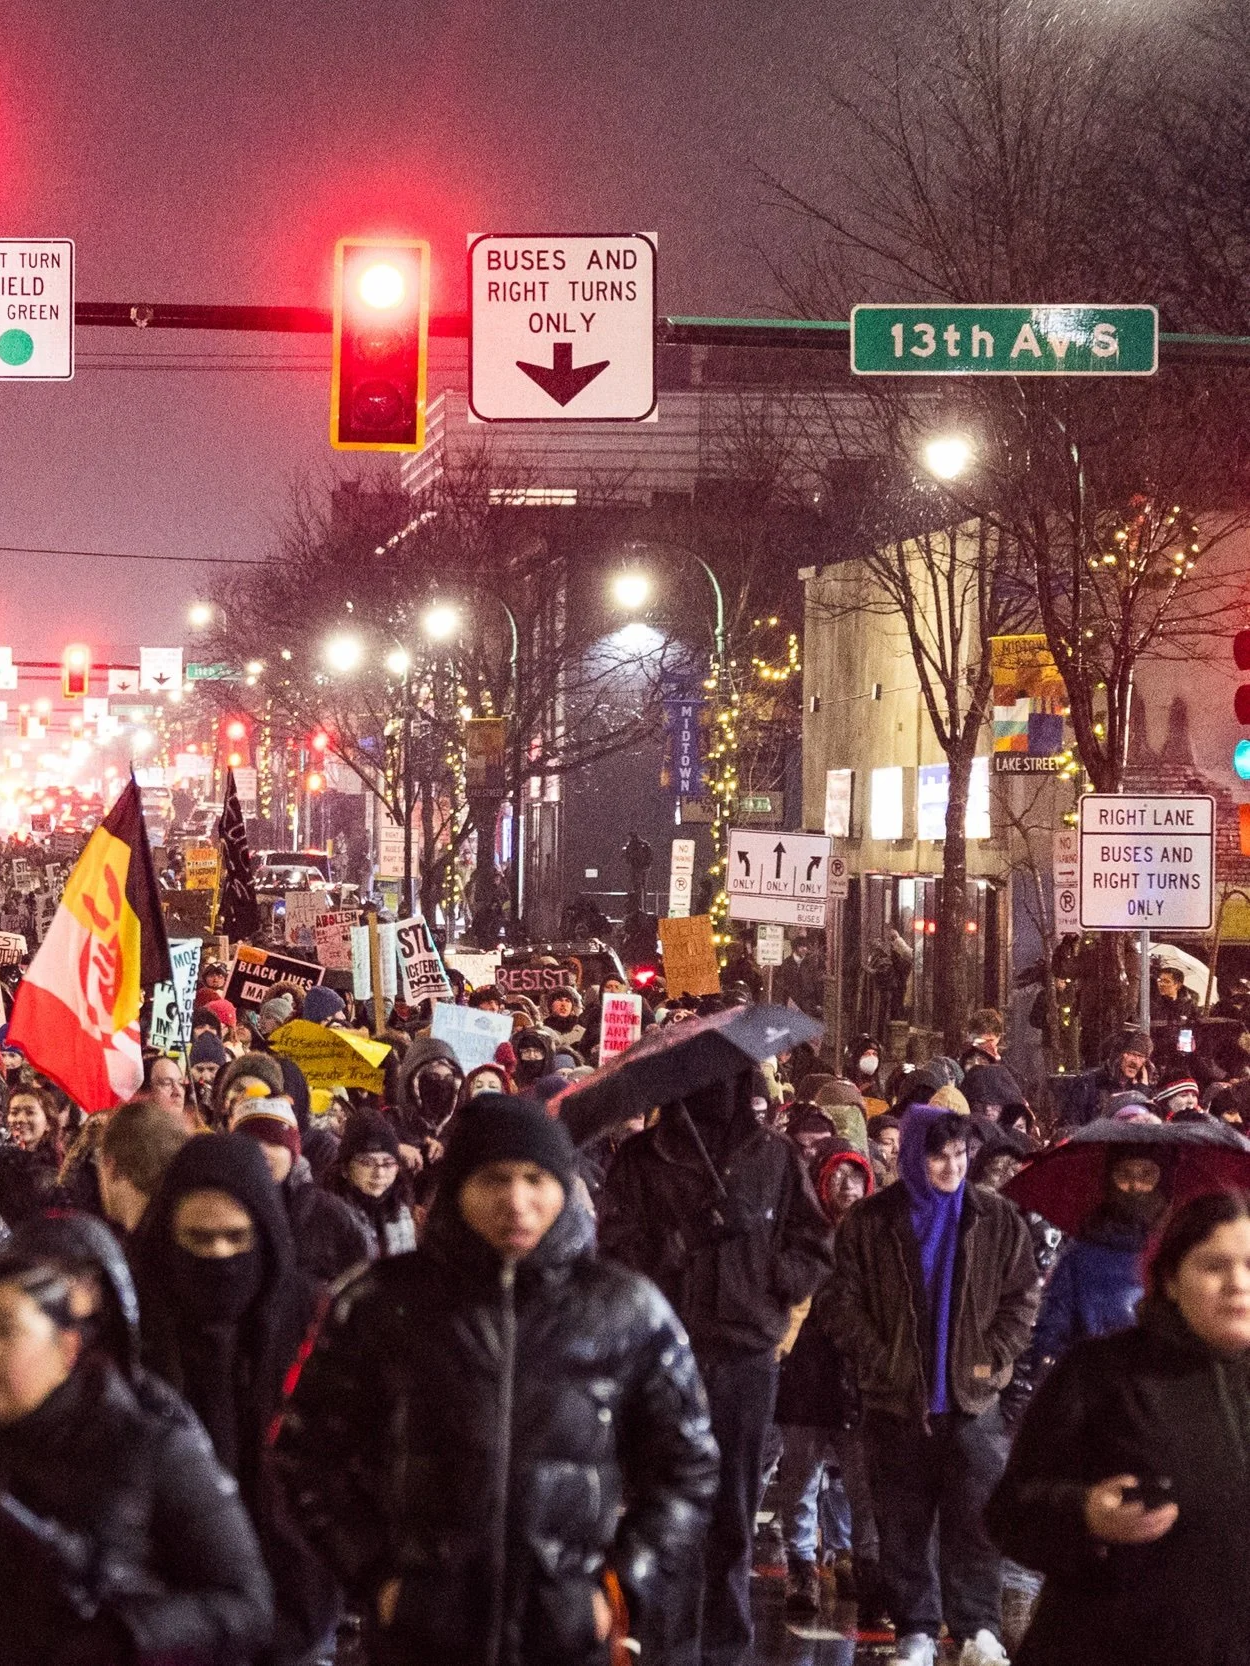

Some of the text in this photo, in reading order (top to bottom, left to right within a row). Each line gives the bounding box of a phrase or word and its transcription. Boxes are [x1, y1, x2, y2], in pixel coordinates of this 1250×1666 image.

[19, 252, 61, 268] TURN
[487, 250, 637, 270] BUSES AND
[488, 281, 637, 302] RIGHT TURNS
[7, 304, 59, 320] GREEN
[529, 312, 596, 333] ONLY
[891, 323, 995, 358] 13th
[1091, 323, 1119, 358] S
[681, 705, 692, 791] MIDTOWN
[996, 757, 1060, 772] LAKE STREET
[1099, 809, 1194, 826] RIGHT LANE
[1100, 846, 1193, 863] BUSES AND
[733, 879, 755, 889] ONLY
[766, 881, 789, 891] ONLY
[800, 883, 822, 894] ONLY
[1093, 872, 1200, 890] RIGHT TURNS
[796, 903, 824, 912] EXCEPT
[1126, 899, 1164, 916] ONLY
[797, 914, 821, 924] BUSES
[451, 956, 485, 968] ISTORY
[238, 960, 314, 992] BLACK LIVES
[408, 973, 448, 990] NOW
[496, 967, 569, 992] RESIST
[606, 1026, 630, 1039] ANY
